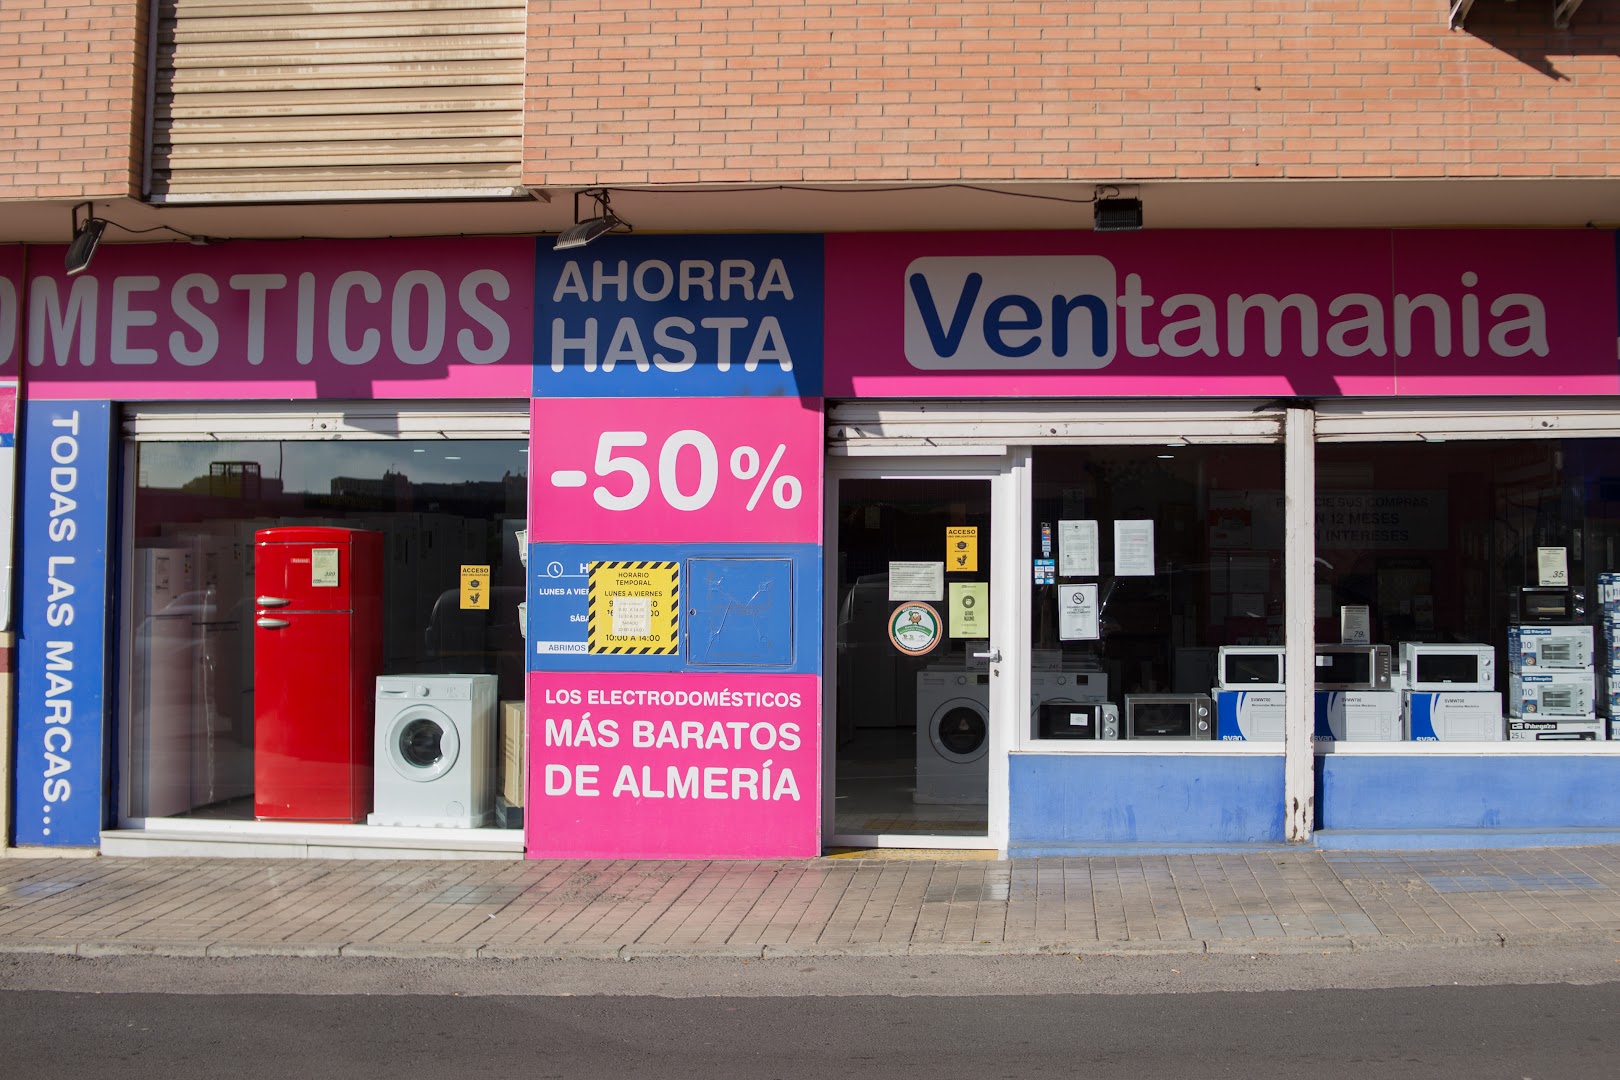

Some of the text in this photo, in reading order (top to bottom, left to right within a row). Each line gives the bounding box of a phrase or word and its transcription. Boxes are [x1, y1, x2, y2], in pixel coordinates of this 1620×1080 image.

[552, 258, 795, 302] AHORRA
[908, 271, 1551, 358] Ventamania
[551, 316, 793, 372] HASTA
[551, 429, 802, 511] -50%
[1326, 529, 1409, 542] INTERESES
[1331, 512, 1344, 524] 12
[1348, 512, 1399, 524] MESES
[566, 588, 573, 596] A
[43, 410, 79, 836] TODAS LAS MARCAS...
[606, 634, 661, 642] 10:00 A 14:00
[548, 644, 586, 652] ABRIMOS
[545, 688, 802, 708] LOS ELECTRODOMÉSTICOS
[545, 712, 801, 751] MÁS BARATOS
[545, 759, 801, 801] DE ALMERÍA
